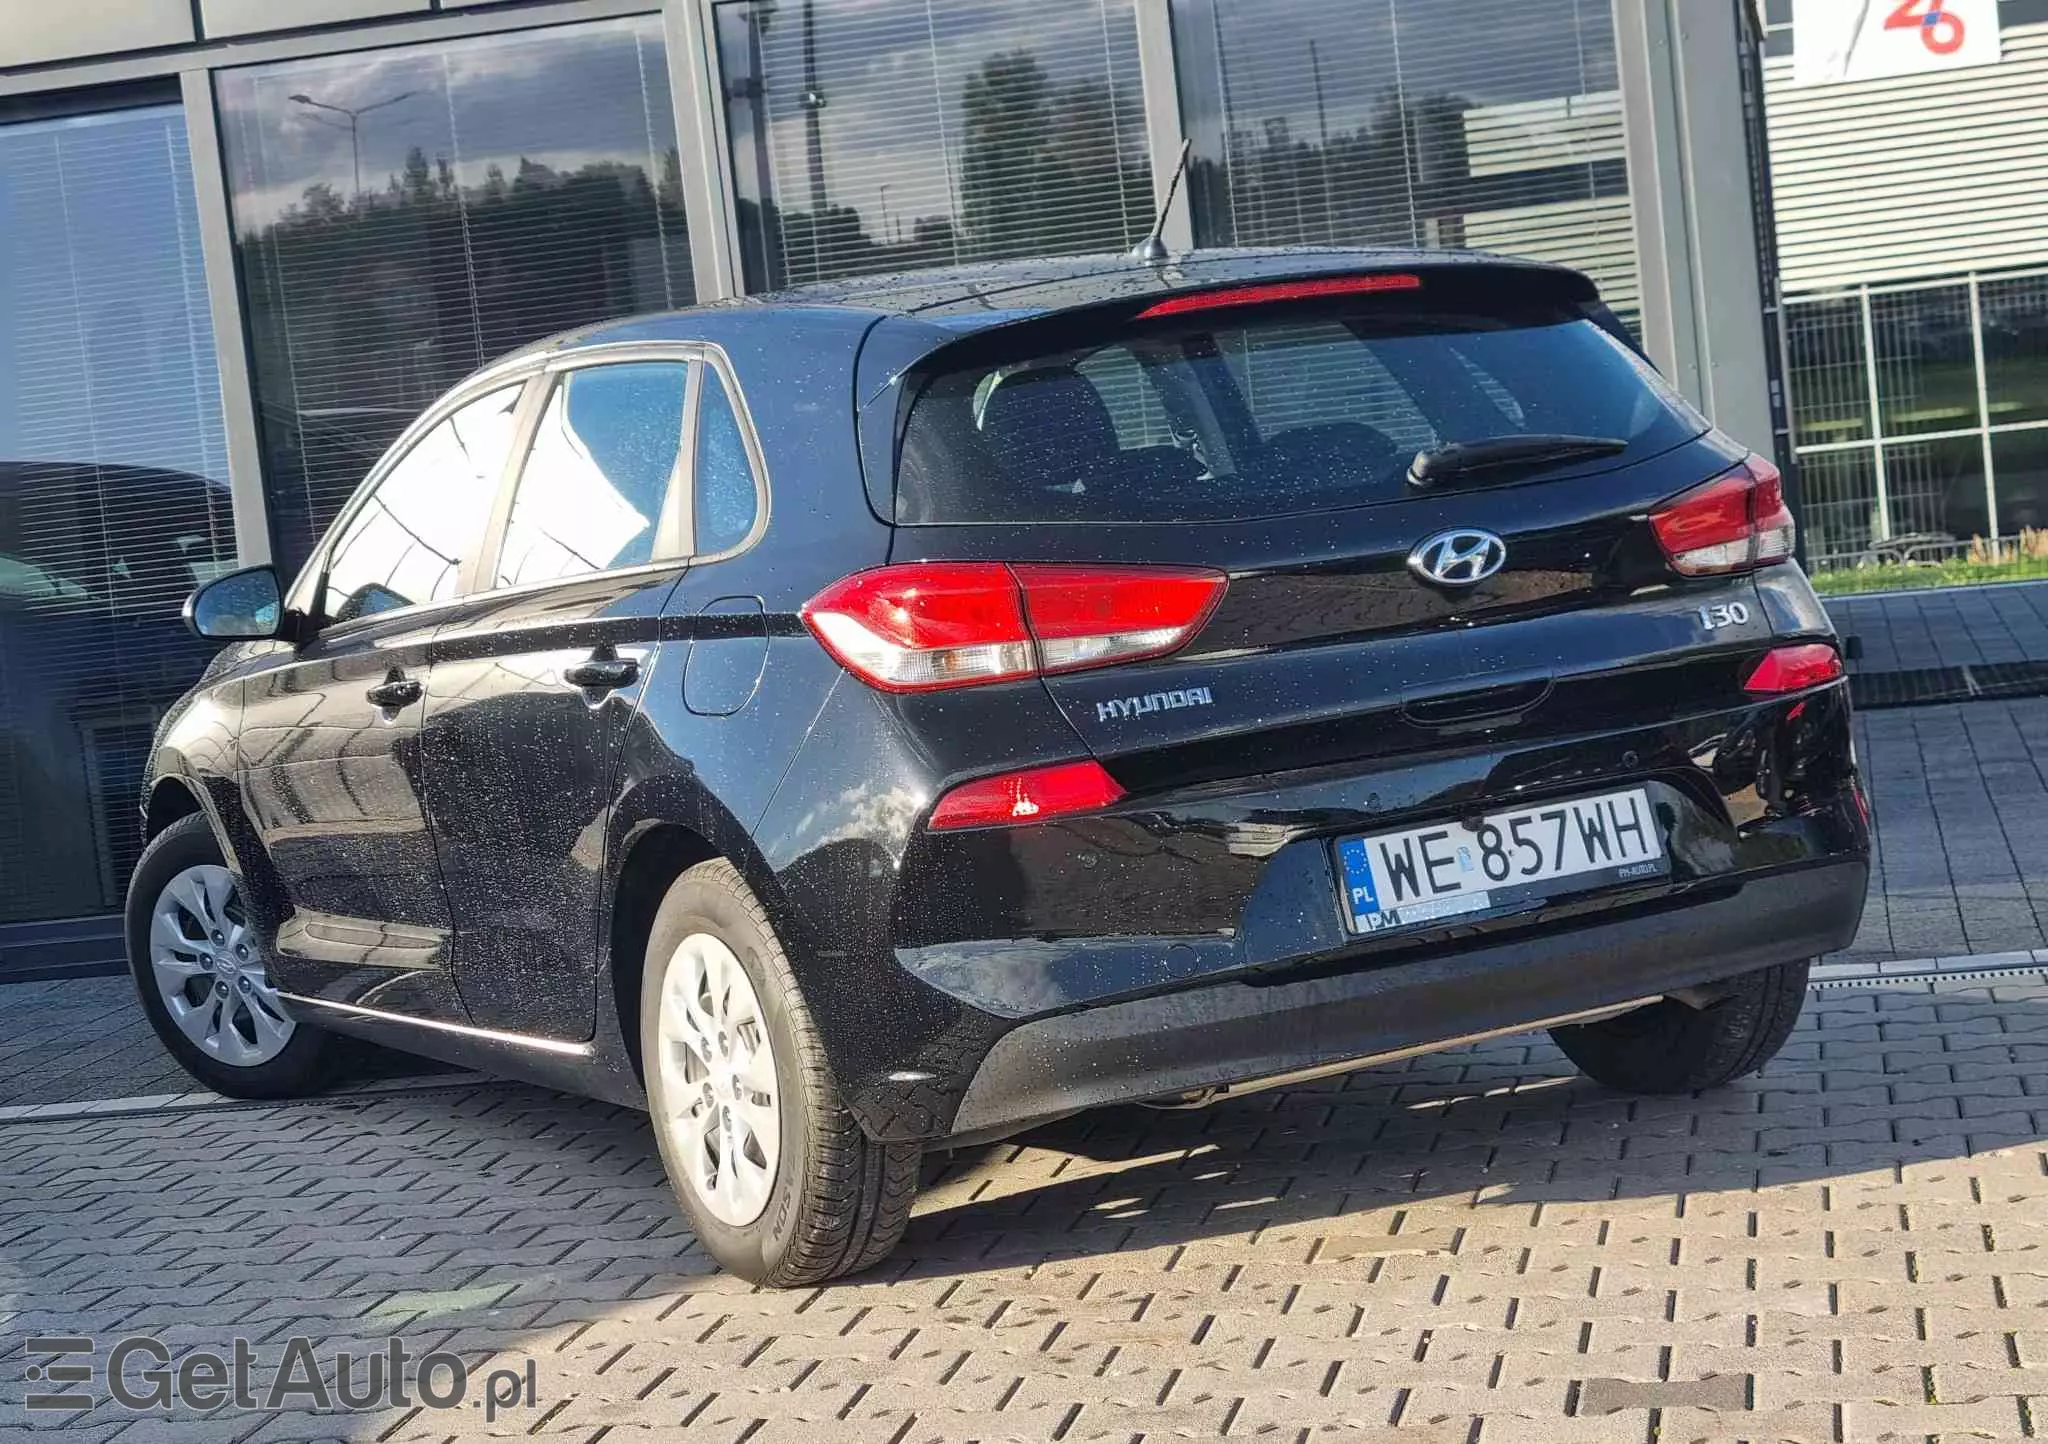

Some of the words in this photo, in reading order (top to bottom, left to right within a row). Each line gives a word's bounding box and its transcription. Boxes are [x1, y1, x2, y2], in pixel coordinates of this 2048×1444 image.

[1096, 687, 1213, 722] HYUNDAI
[1379, 831, 1462, 902] WE
[1477, 797, 1649, 882] 857WH
[1352, 886, 1375, 905] PL
